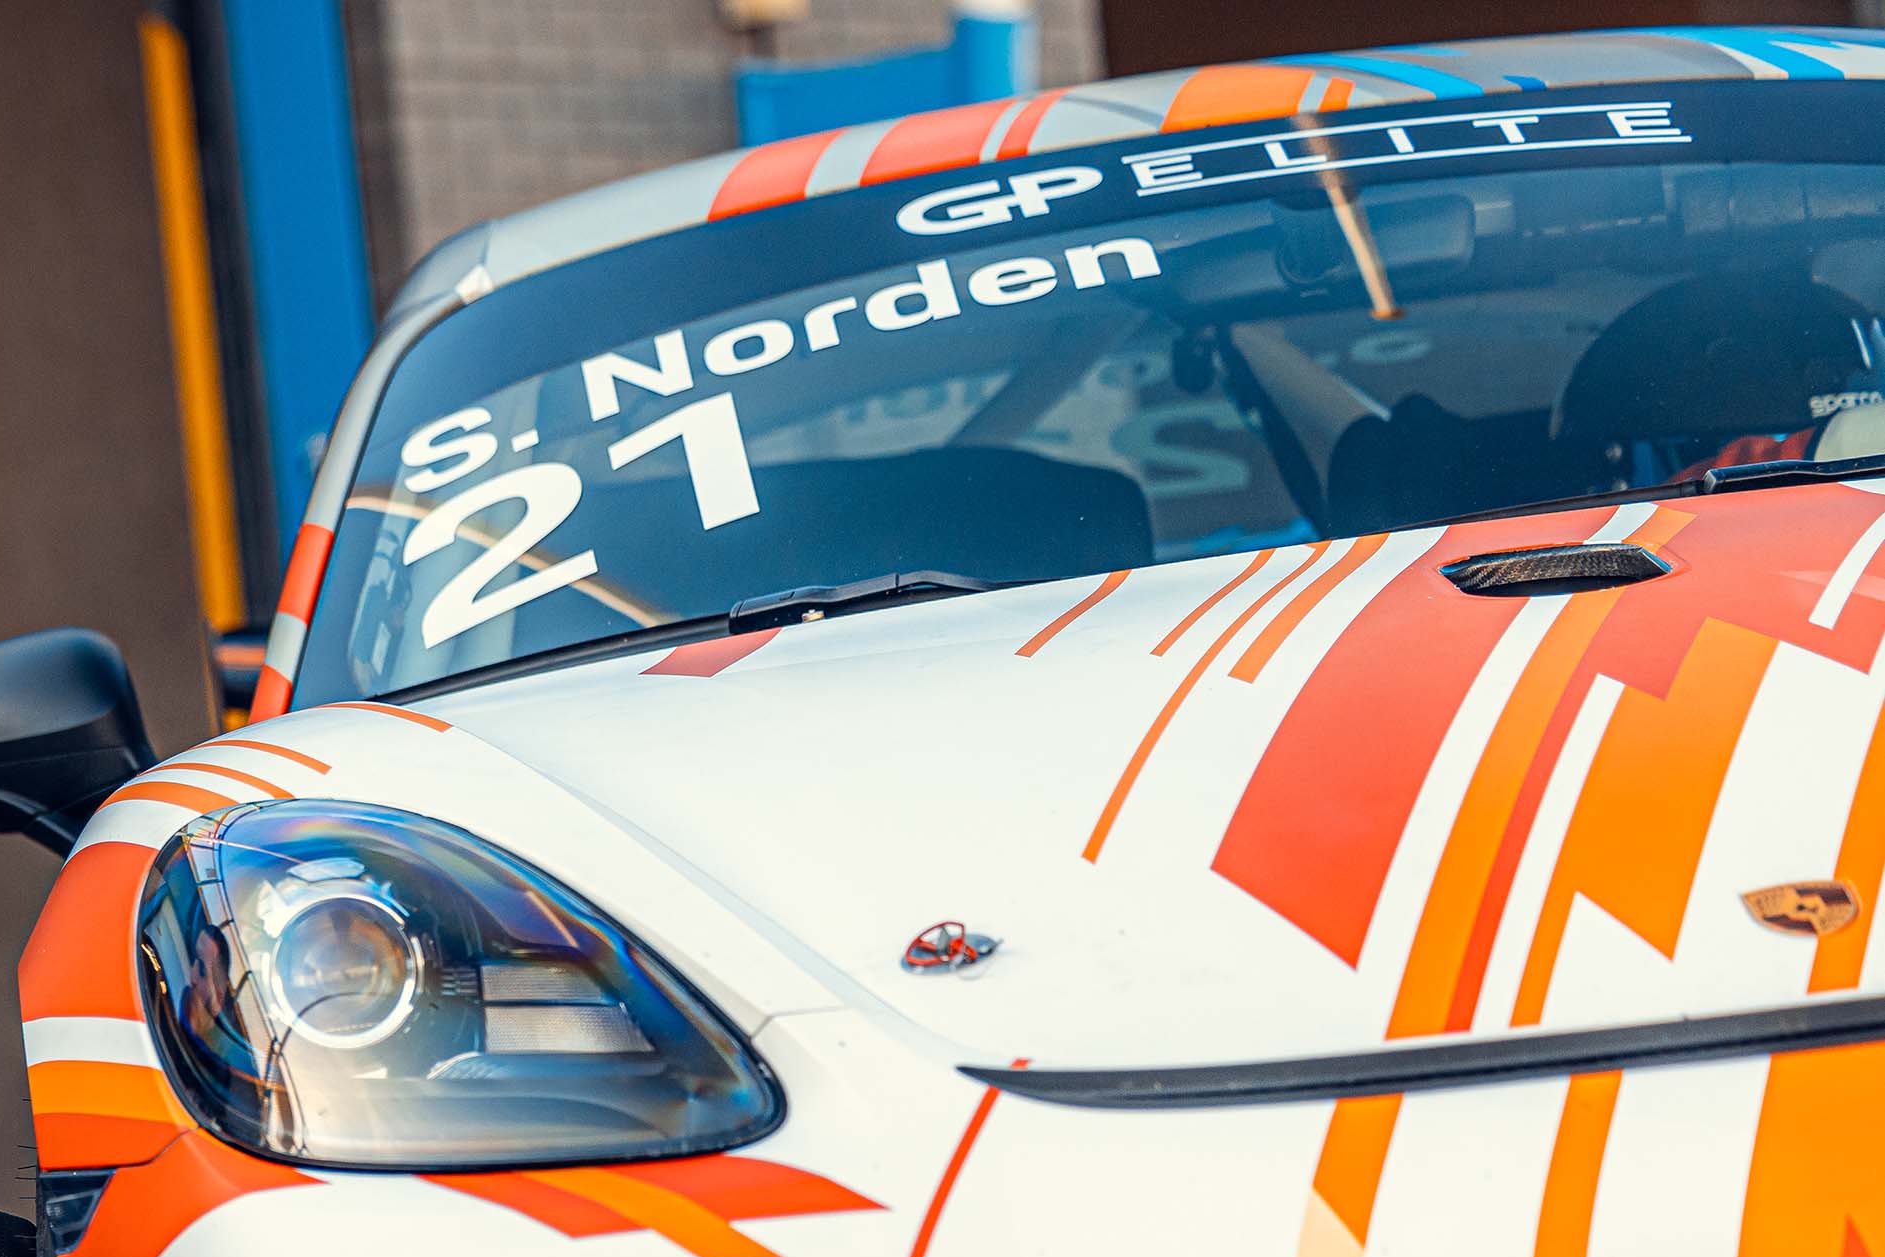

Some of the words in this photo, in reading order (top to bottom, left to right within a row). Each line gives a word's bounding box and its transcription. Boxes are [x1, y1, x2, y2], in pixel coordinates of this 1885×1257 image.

[896, 165, 1103, 236] GP
[1133, 105, 1684, 193] ELITE
[401, 406, 540, 494] S.
[581, 237, 1162, 421] Norden
[402, 391, 761, 650] 21
